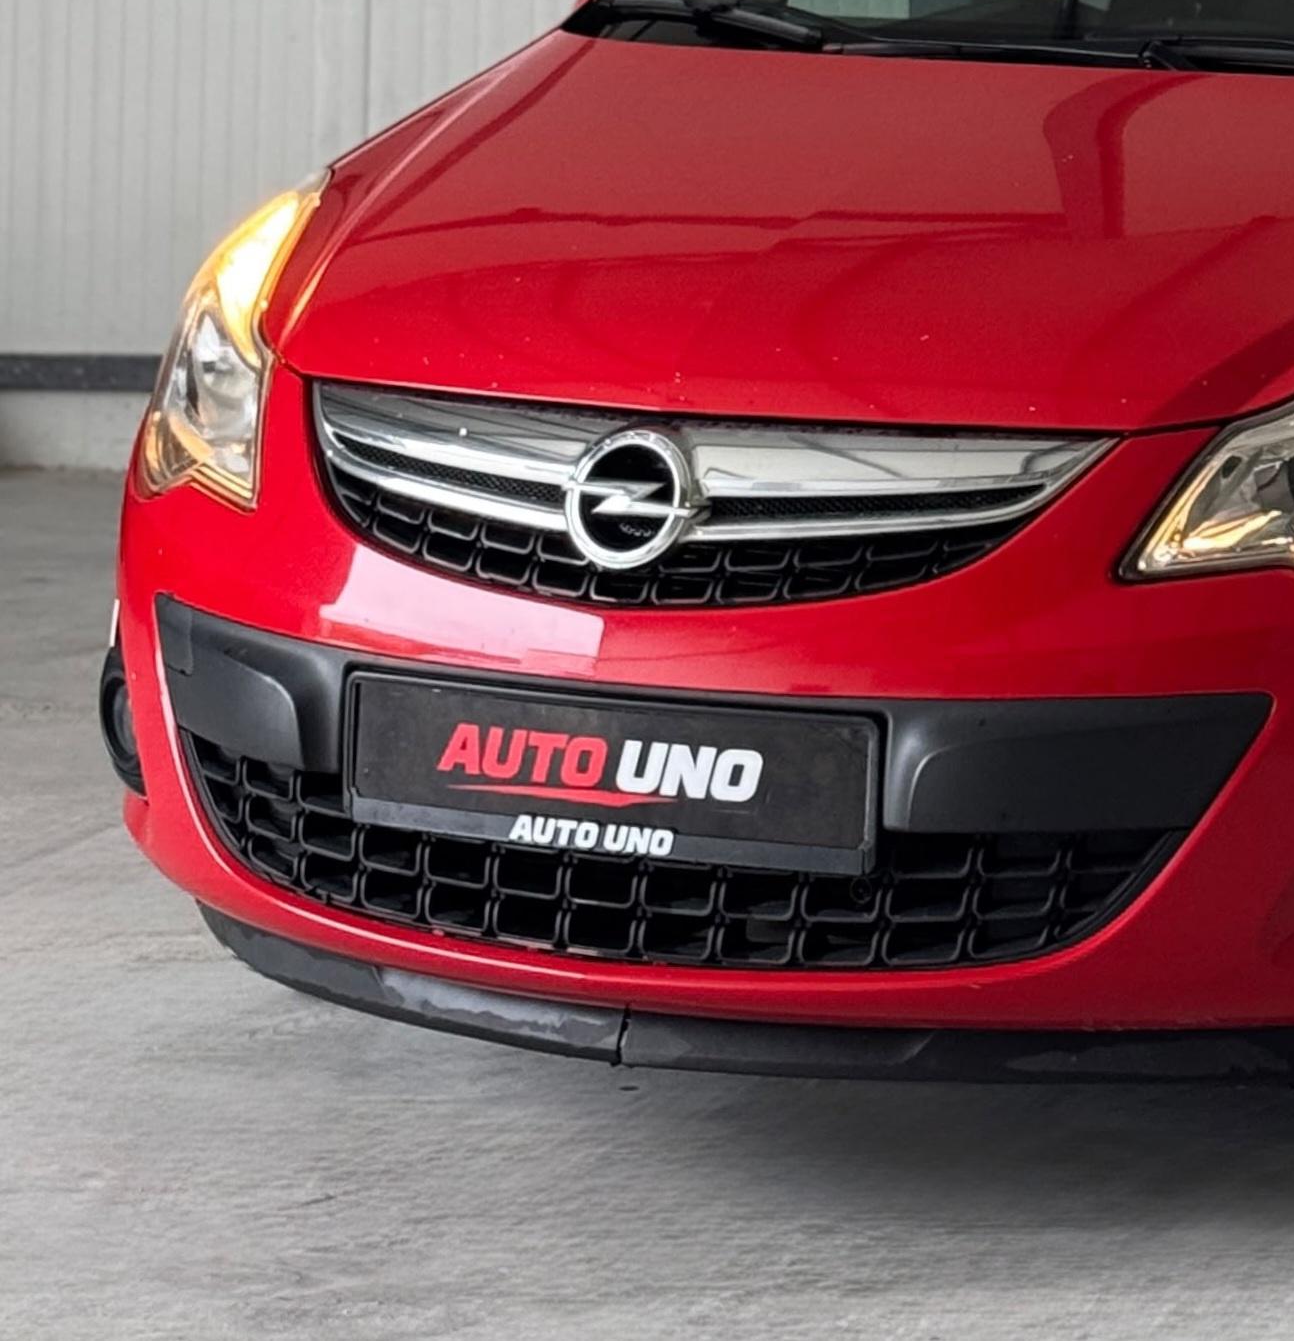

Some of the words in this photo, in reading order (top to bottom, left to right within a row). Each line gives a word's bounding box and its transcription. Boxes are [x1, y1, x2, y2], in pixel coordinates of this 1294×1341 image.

[437, 722, 608, 788] AUTO
[616, 739, 764, 803] UNO
[509, 814, 600, 849] AUTO
[603, 823, 675, 857] UNO
